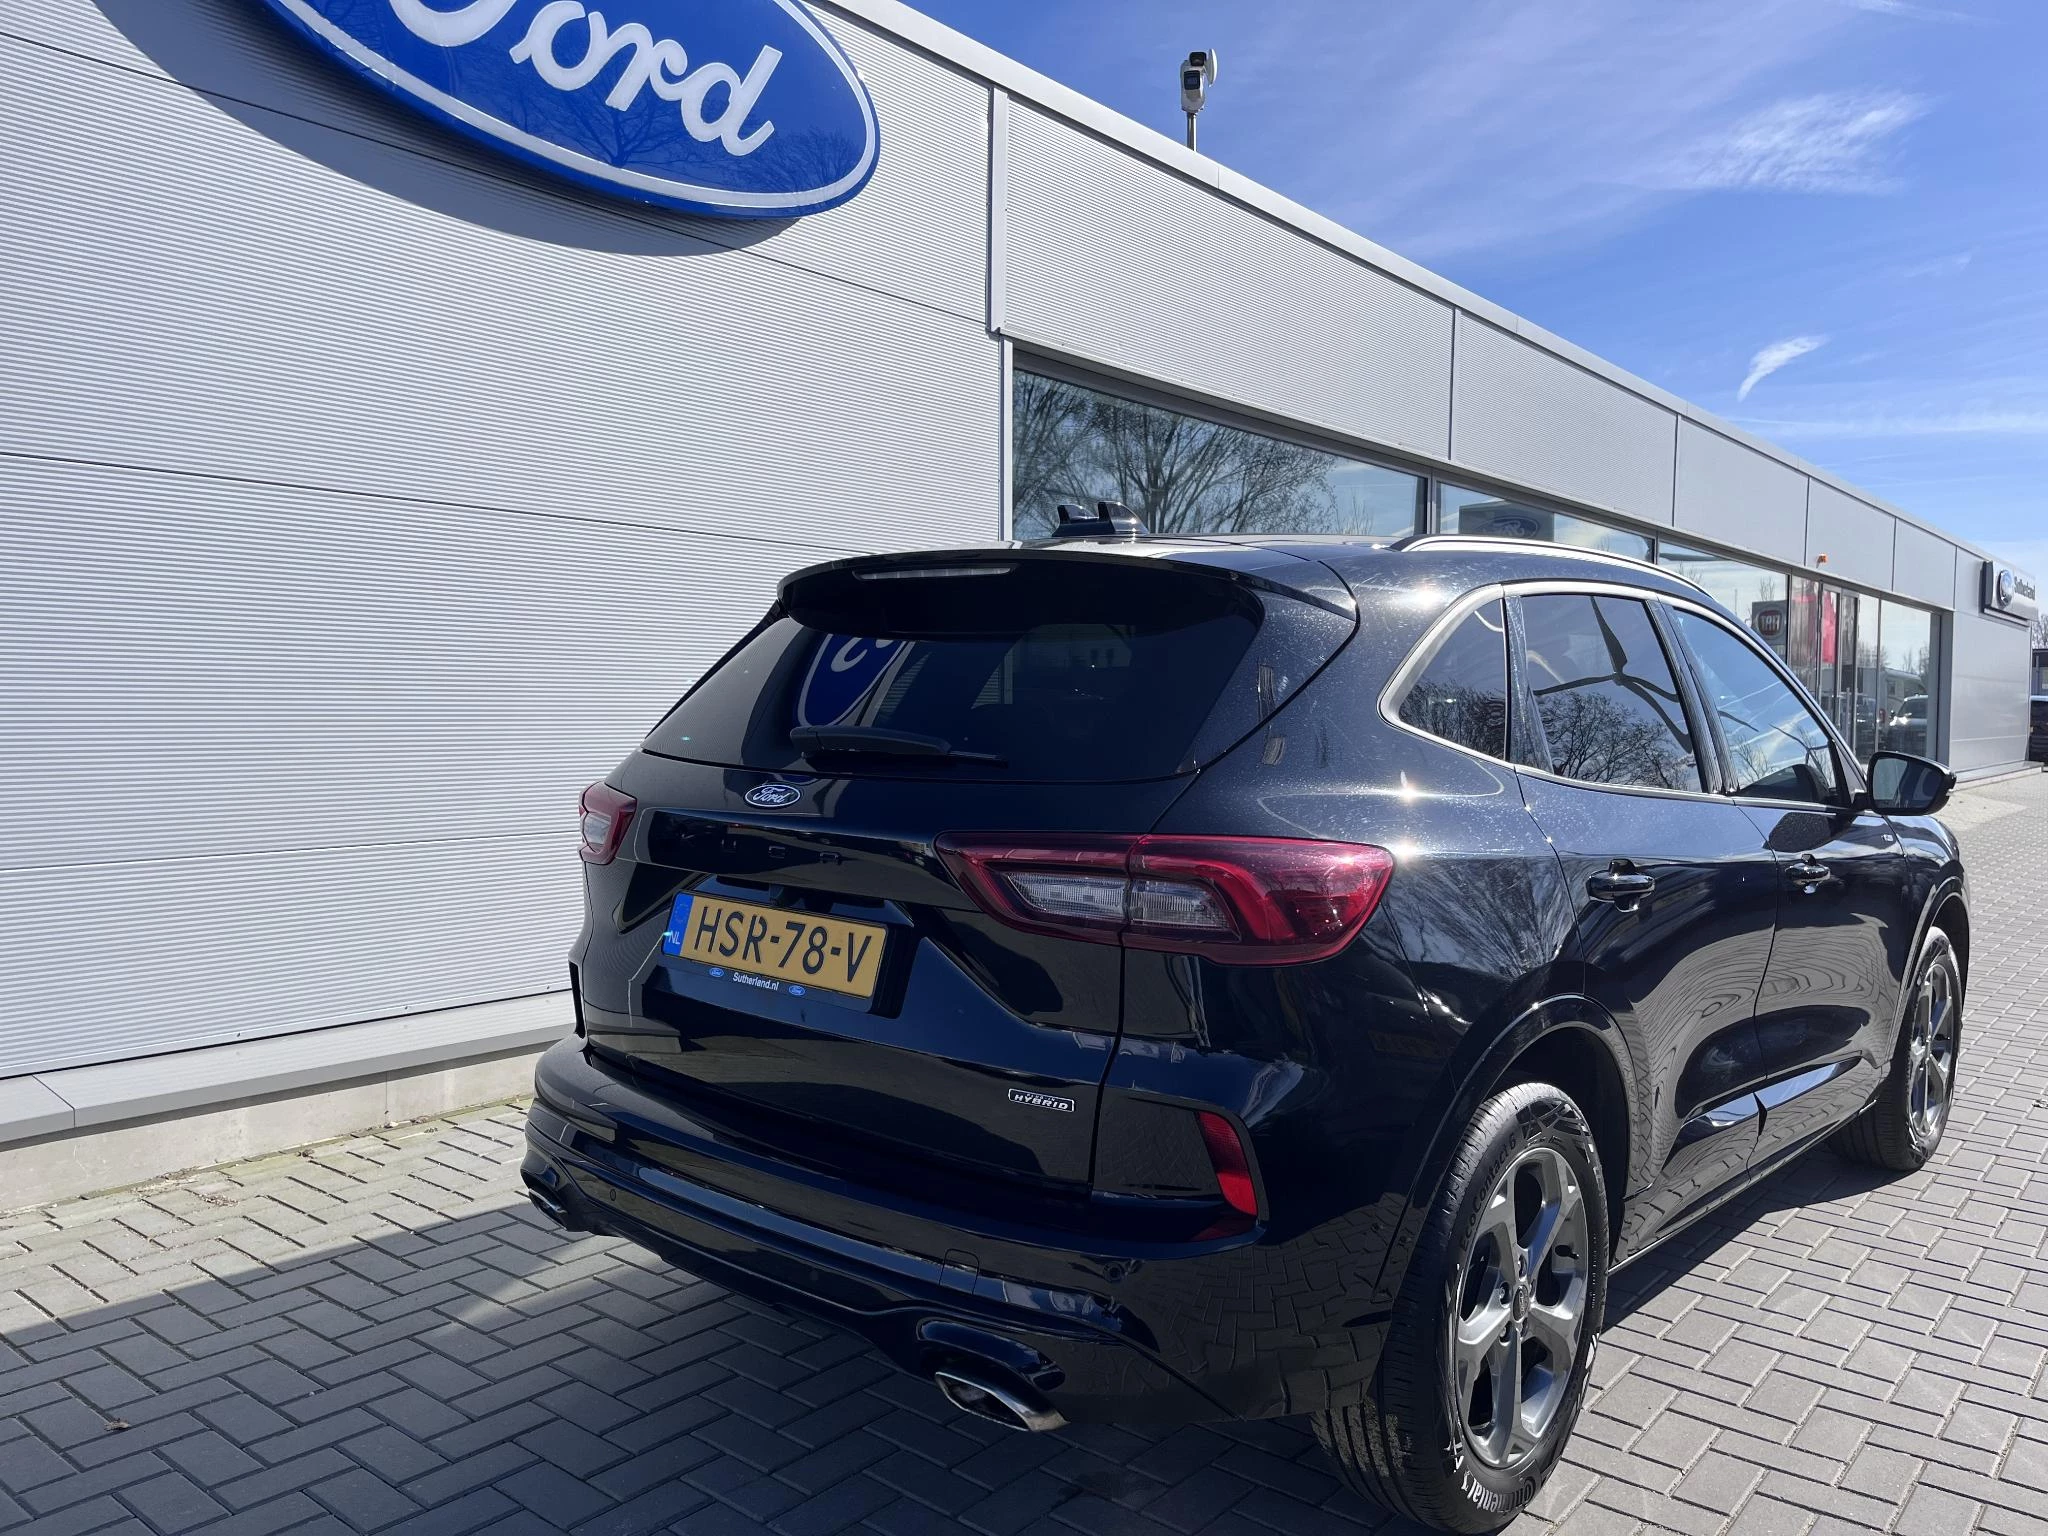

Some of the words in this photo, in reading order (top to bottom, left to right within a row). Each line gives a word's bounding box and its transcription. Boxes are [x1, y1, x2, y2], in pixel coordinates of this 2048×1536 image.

[752, 786, 794, 803] Ford
[668, 930, 681, 945] NL
[693, 906, 872, 983] HSR-78-V
[732, 971, 780, 991] Sutherland.nl
[1014, 1094, 1069, 1110] HYBRID
